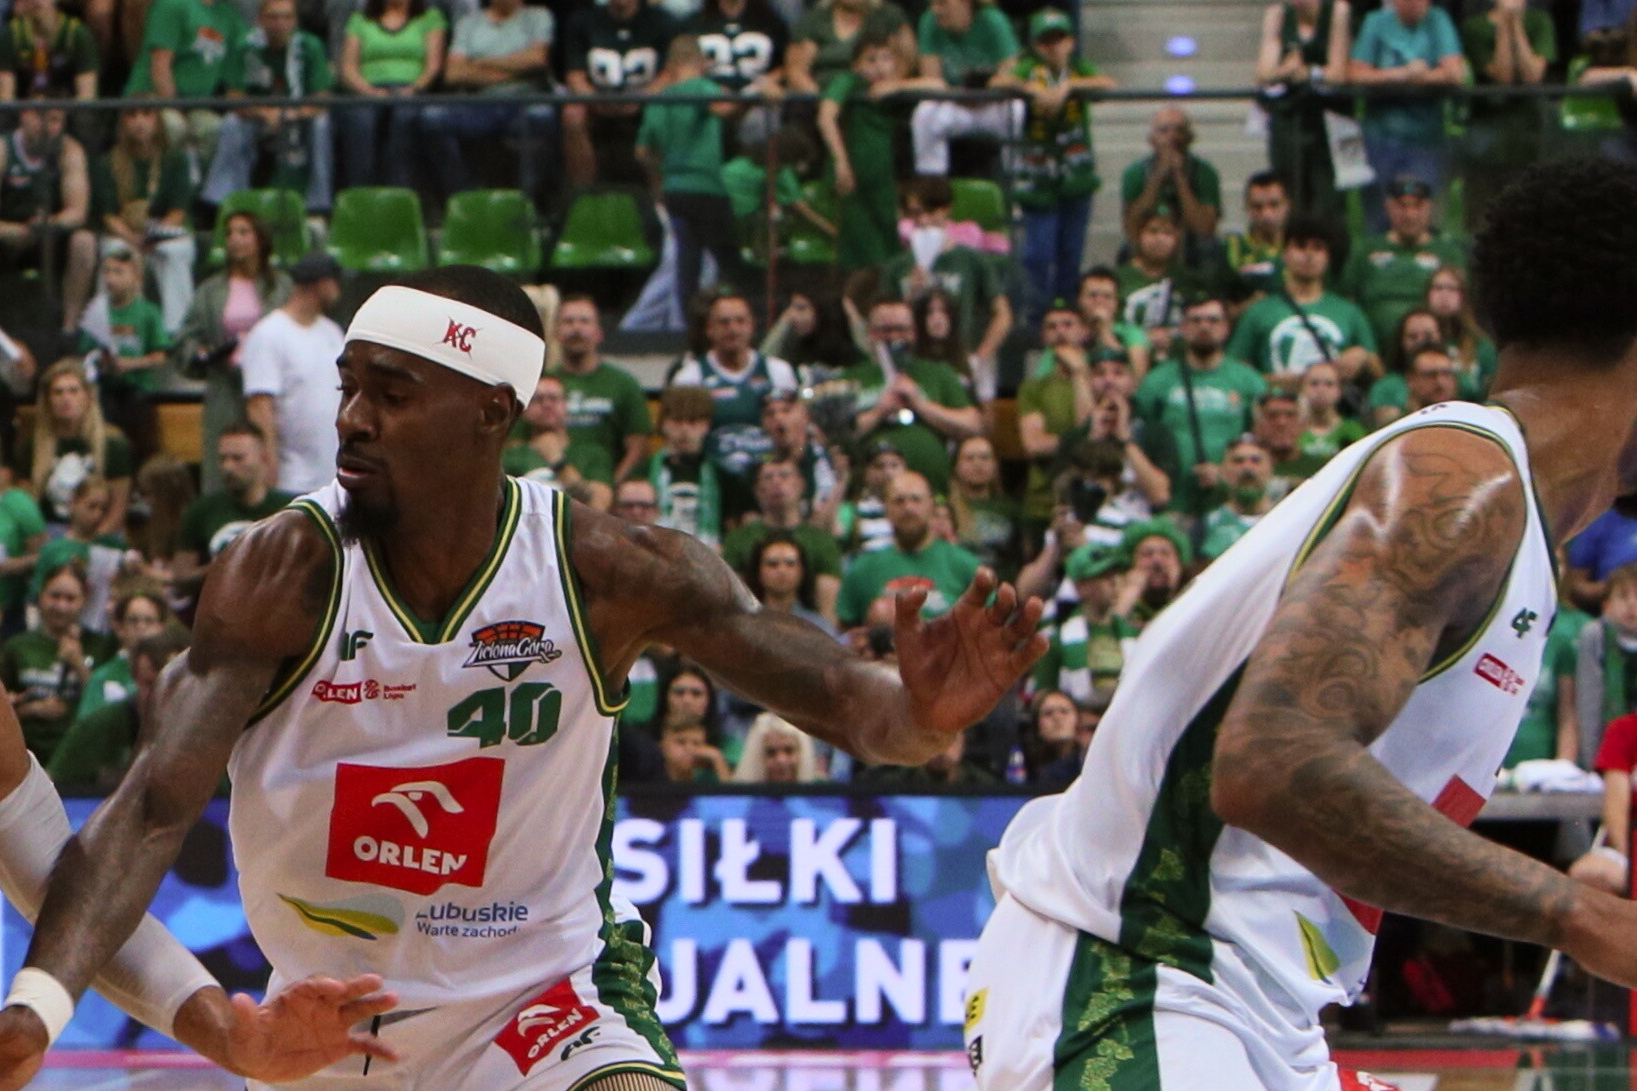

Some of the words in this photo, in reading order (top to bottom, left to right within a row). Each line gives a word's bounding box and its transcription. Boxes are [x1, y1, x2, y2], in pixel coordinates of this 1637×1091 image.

[447, 681, 563, 750] 40
[353, 836, 468, 876] ORLEN
[527, 1007, 583, 1059] ORLEN
